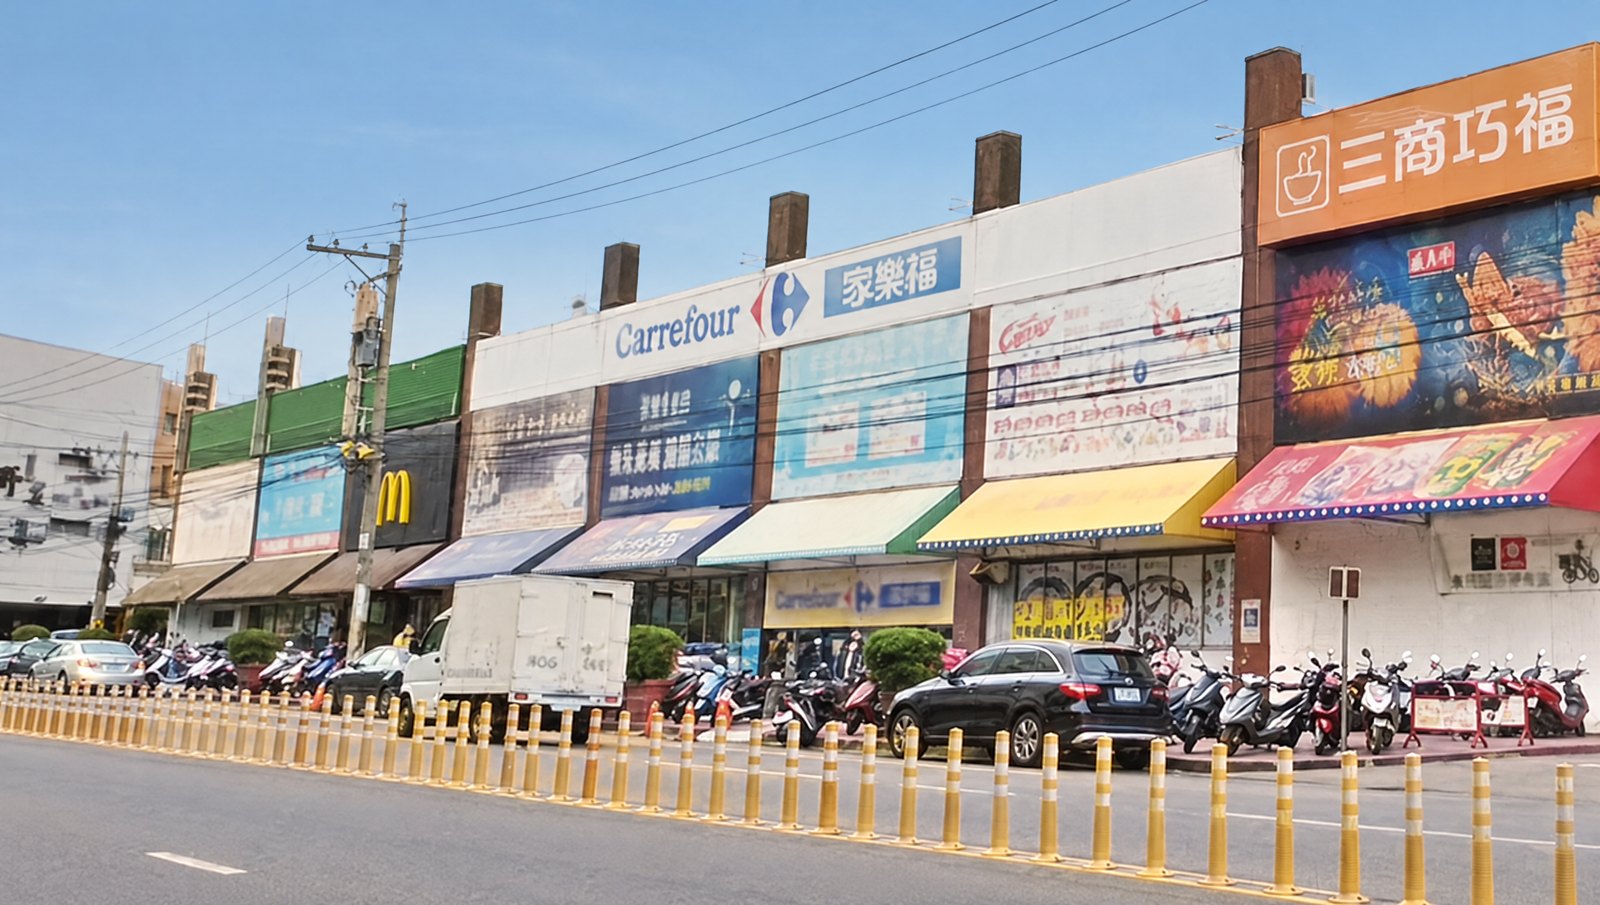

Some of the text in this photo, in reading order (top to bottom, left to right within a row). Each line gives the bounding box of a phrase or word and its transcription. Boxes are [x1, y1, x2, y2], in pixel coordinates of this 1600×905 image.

[1338, 83, 1574, 194] 三商巧福
[842, 248, 938, 309] 家樂福
[615, 303, 740, 359] Carrefour
